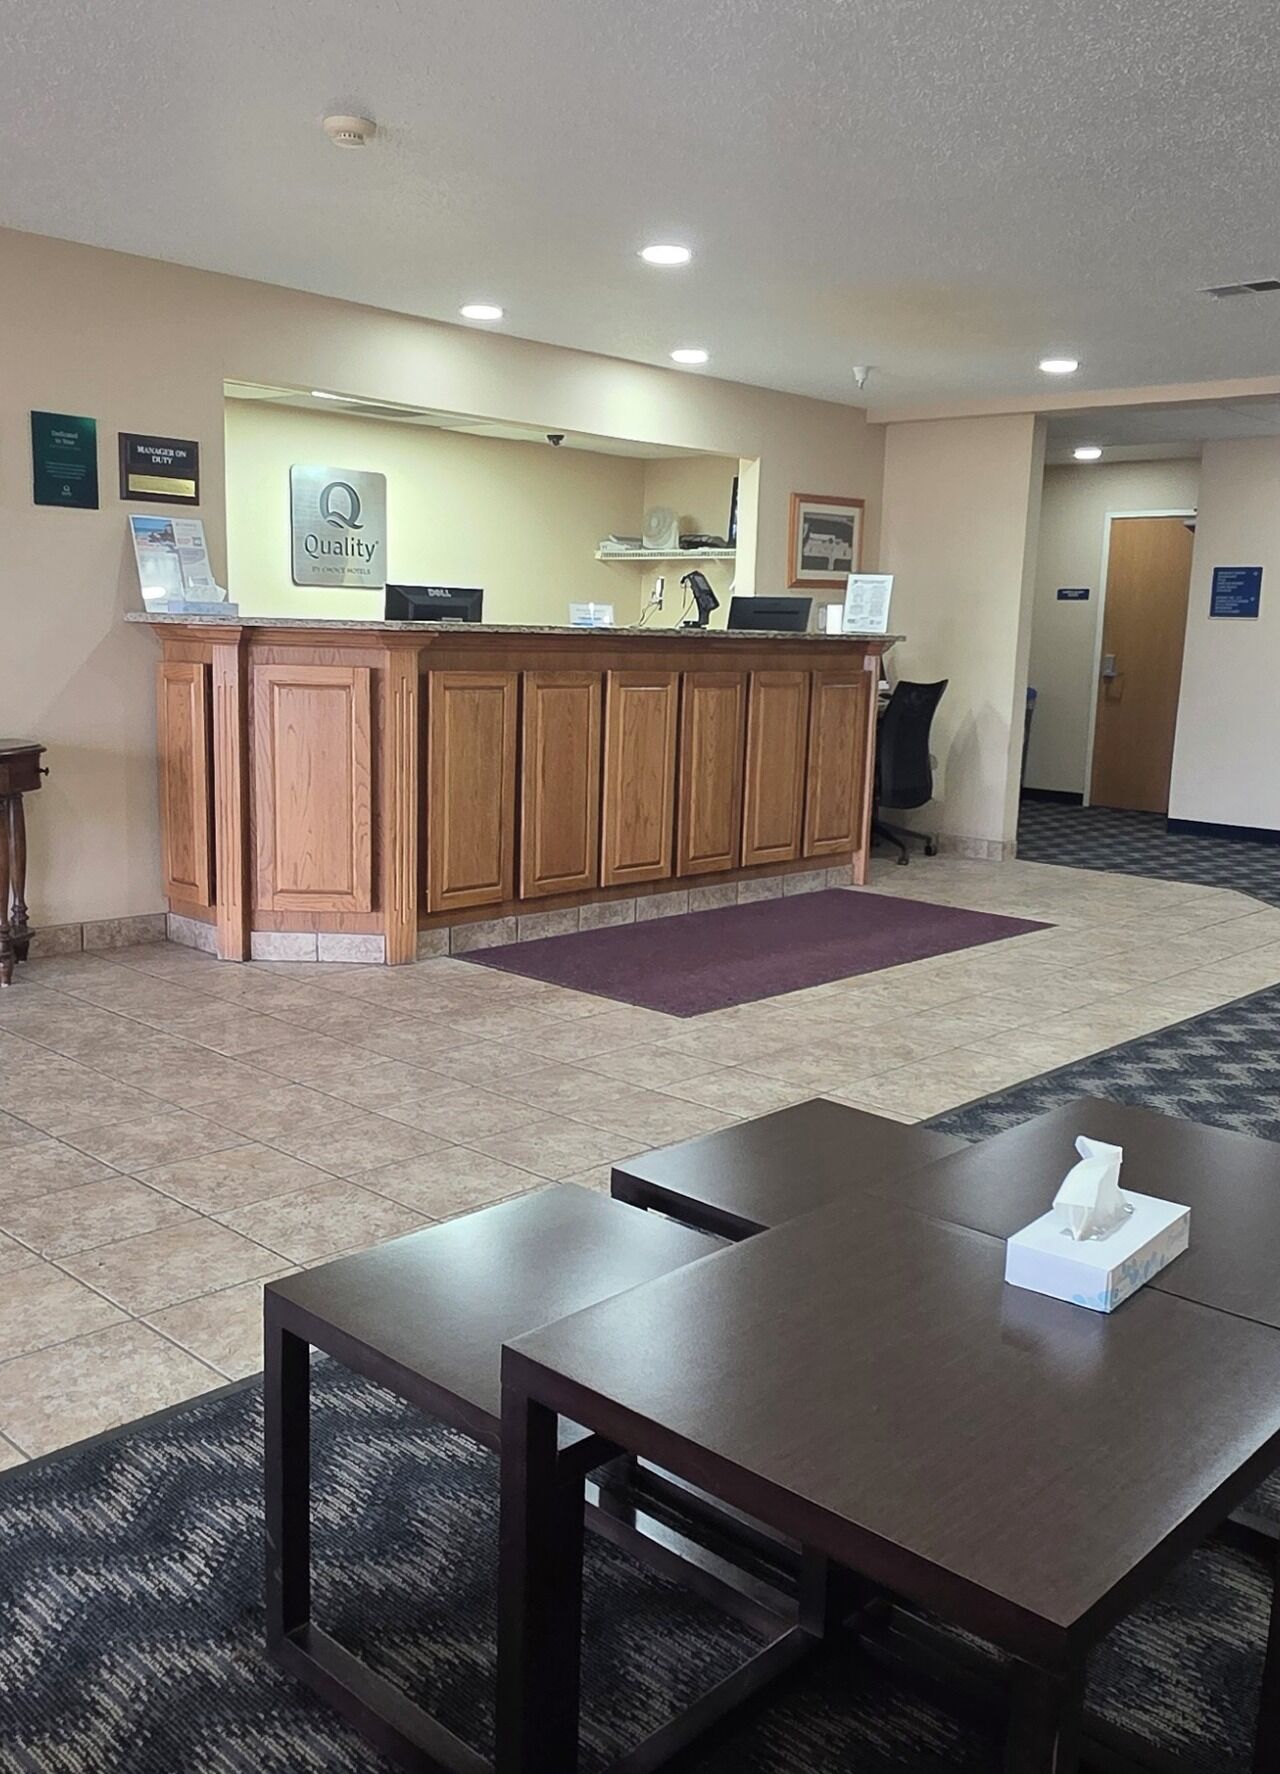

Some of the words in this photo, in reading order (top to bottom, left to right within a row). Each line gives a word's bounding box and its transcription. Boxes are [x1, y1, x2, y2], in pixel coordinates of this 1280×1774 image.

[137, 445, 174, 457] MANAGER
[175, 449, 187, 458] ON
[151, 455, 173, 465] DUTY
[304, 533, 377, 562] Quality
[427, 588, 452, 598] DELL
